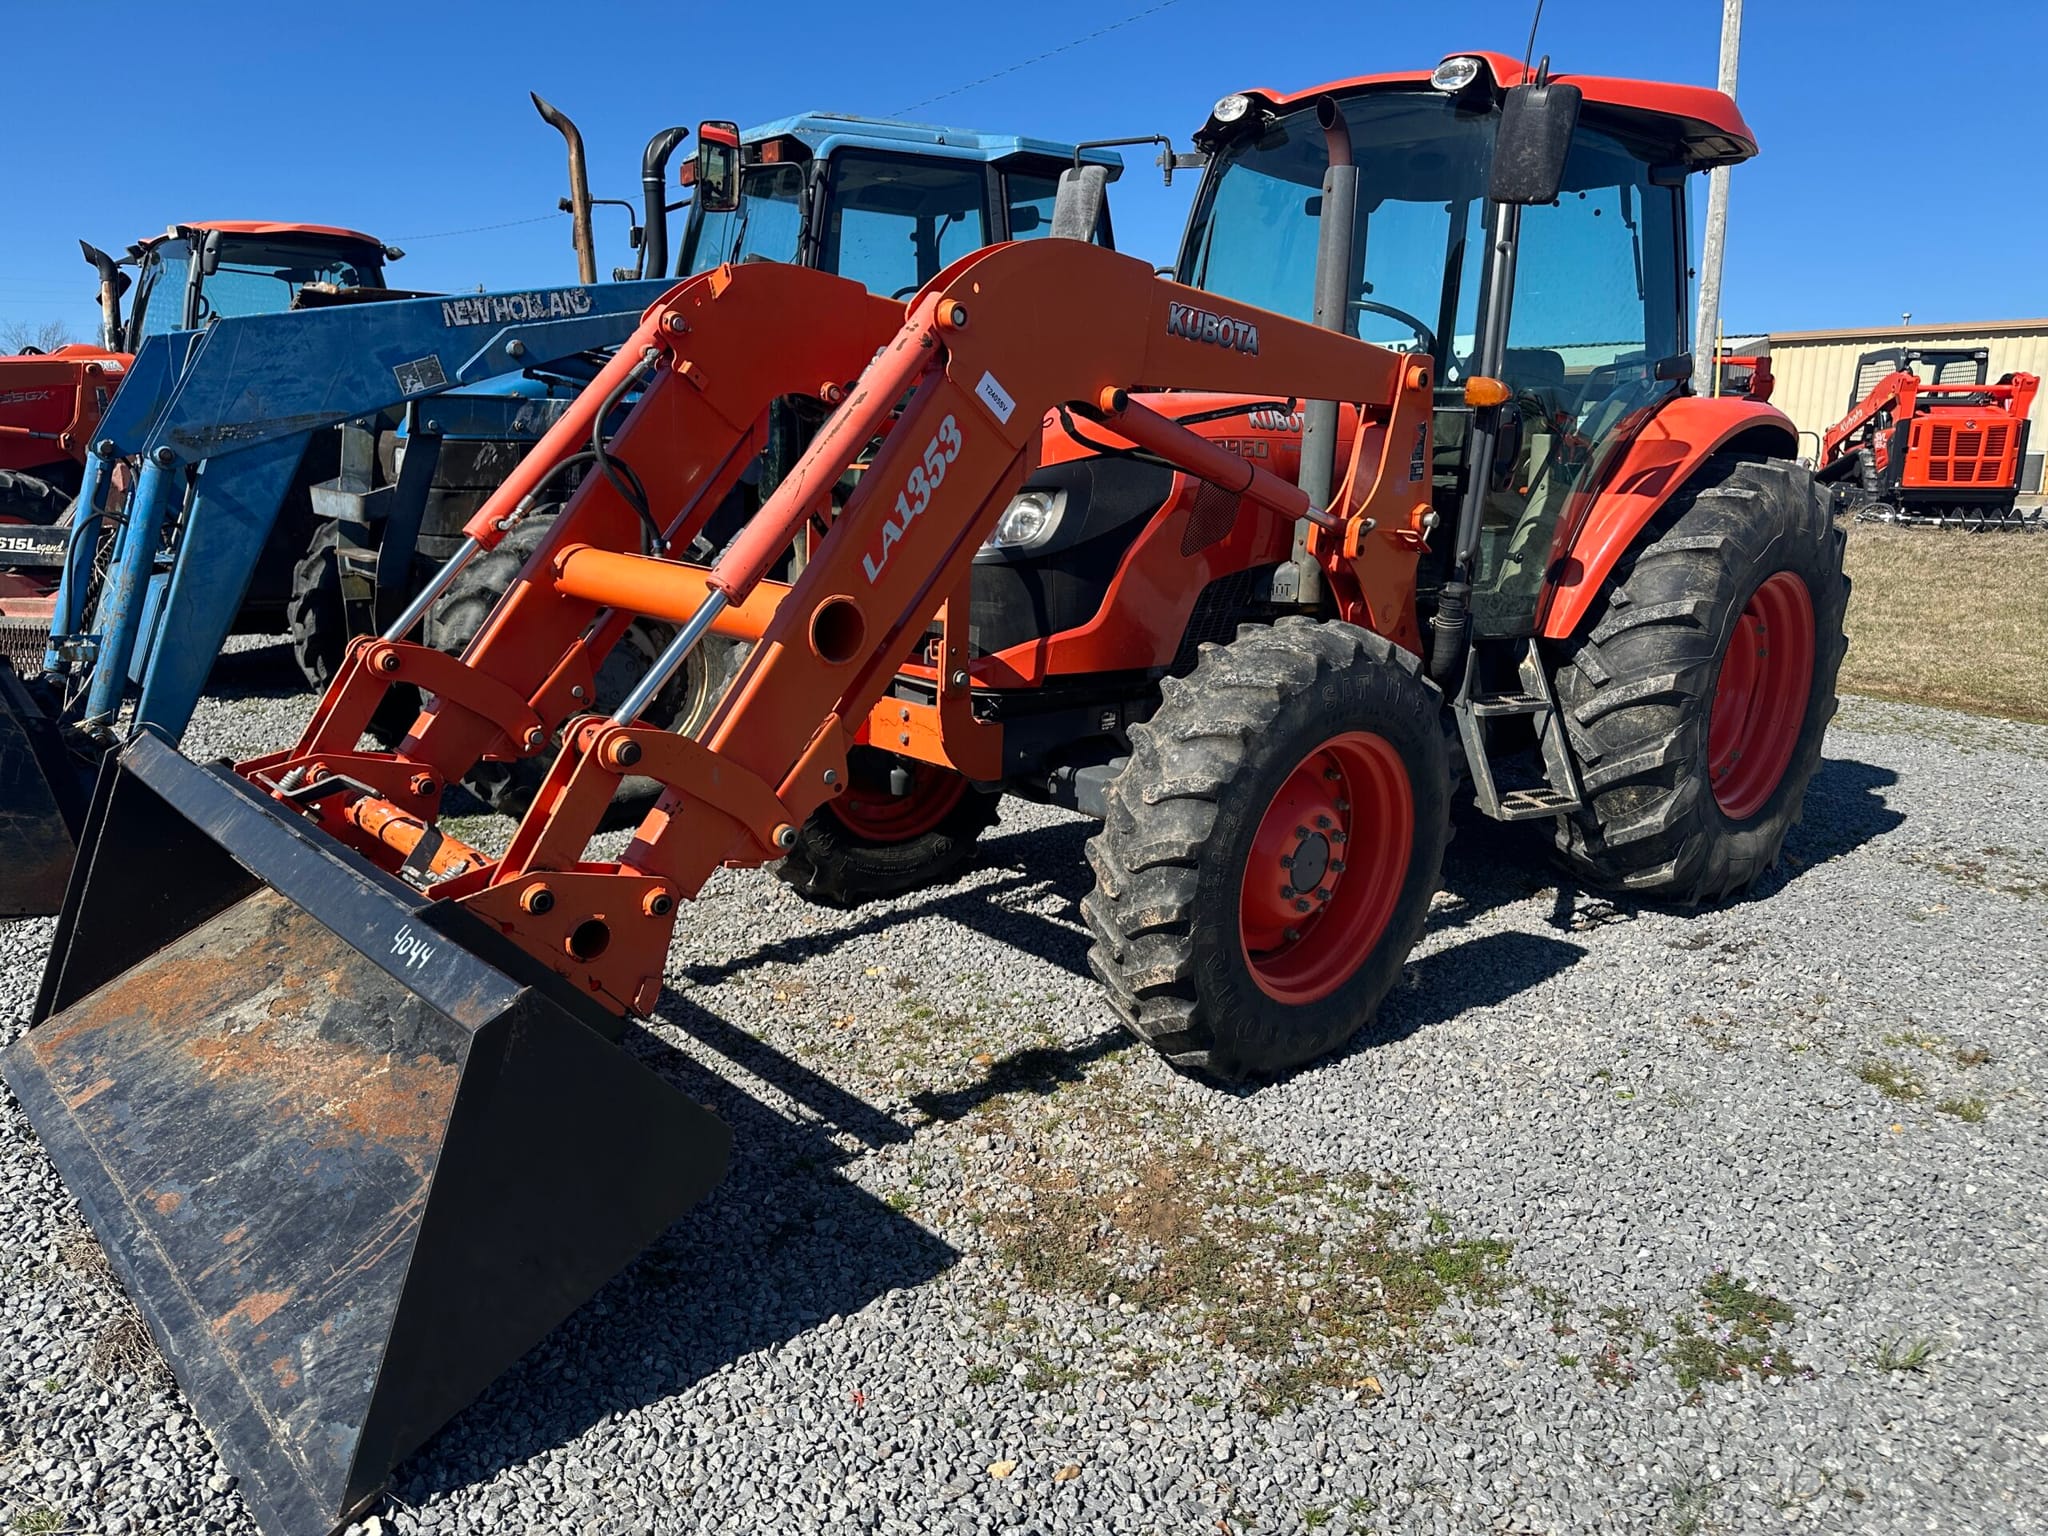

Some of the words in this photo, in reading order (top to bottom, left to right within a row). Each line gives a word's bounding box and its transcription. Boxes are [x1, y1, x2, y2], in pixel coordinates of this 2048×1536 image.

[441, 297, 491, 327] NEW
[494, 287, 592, 322] HOLLAND
[1167, 302, 1260, 357] KUBOTA
[862, 414, 963, 585] LA1353
[389, 923, 437, 970] 4044
